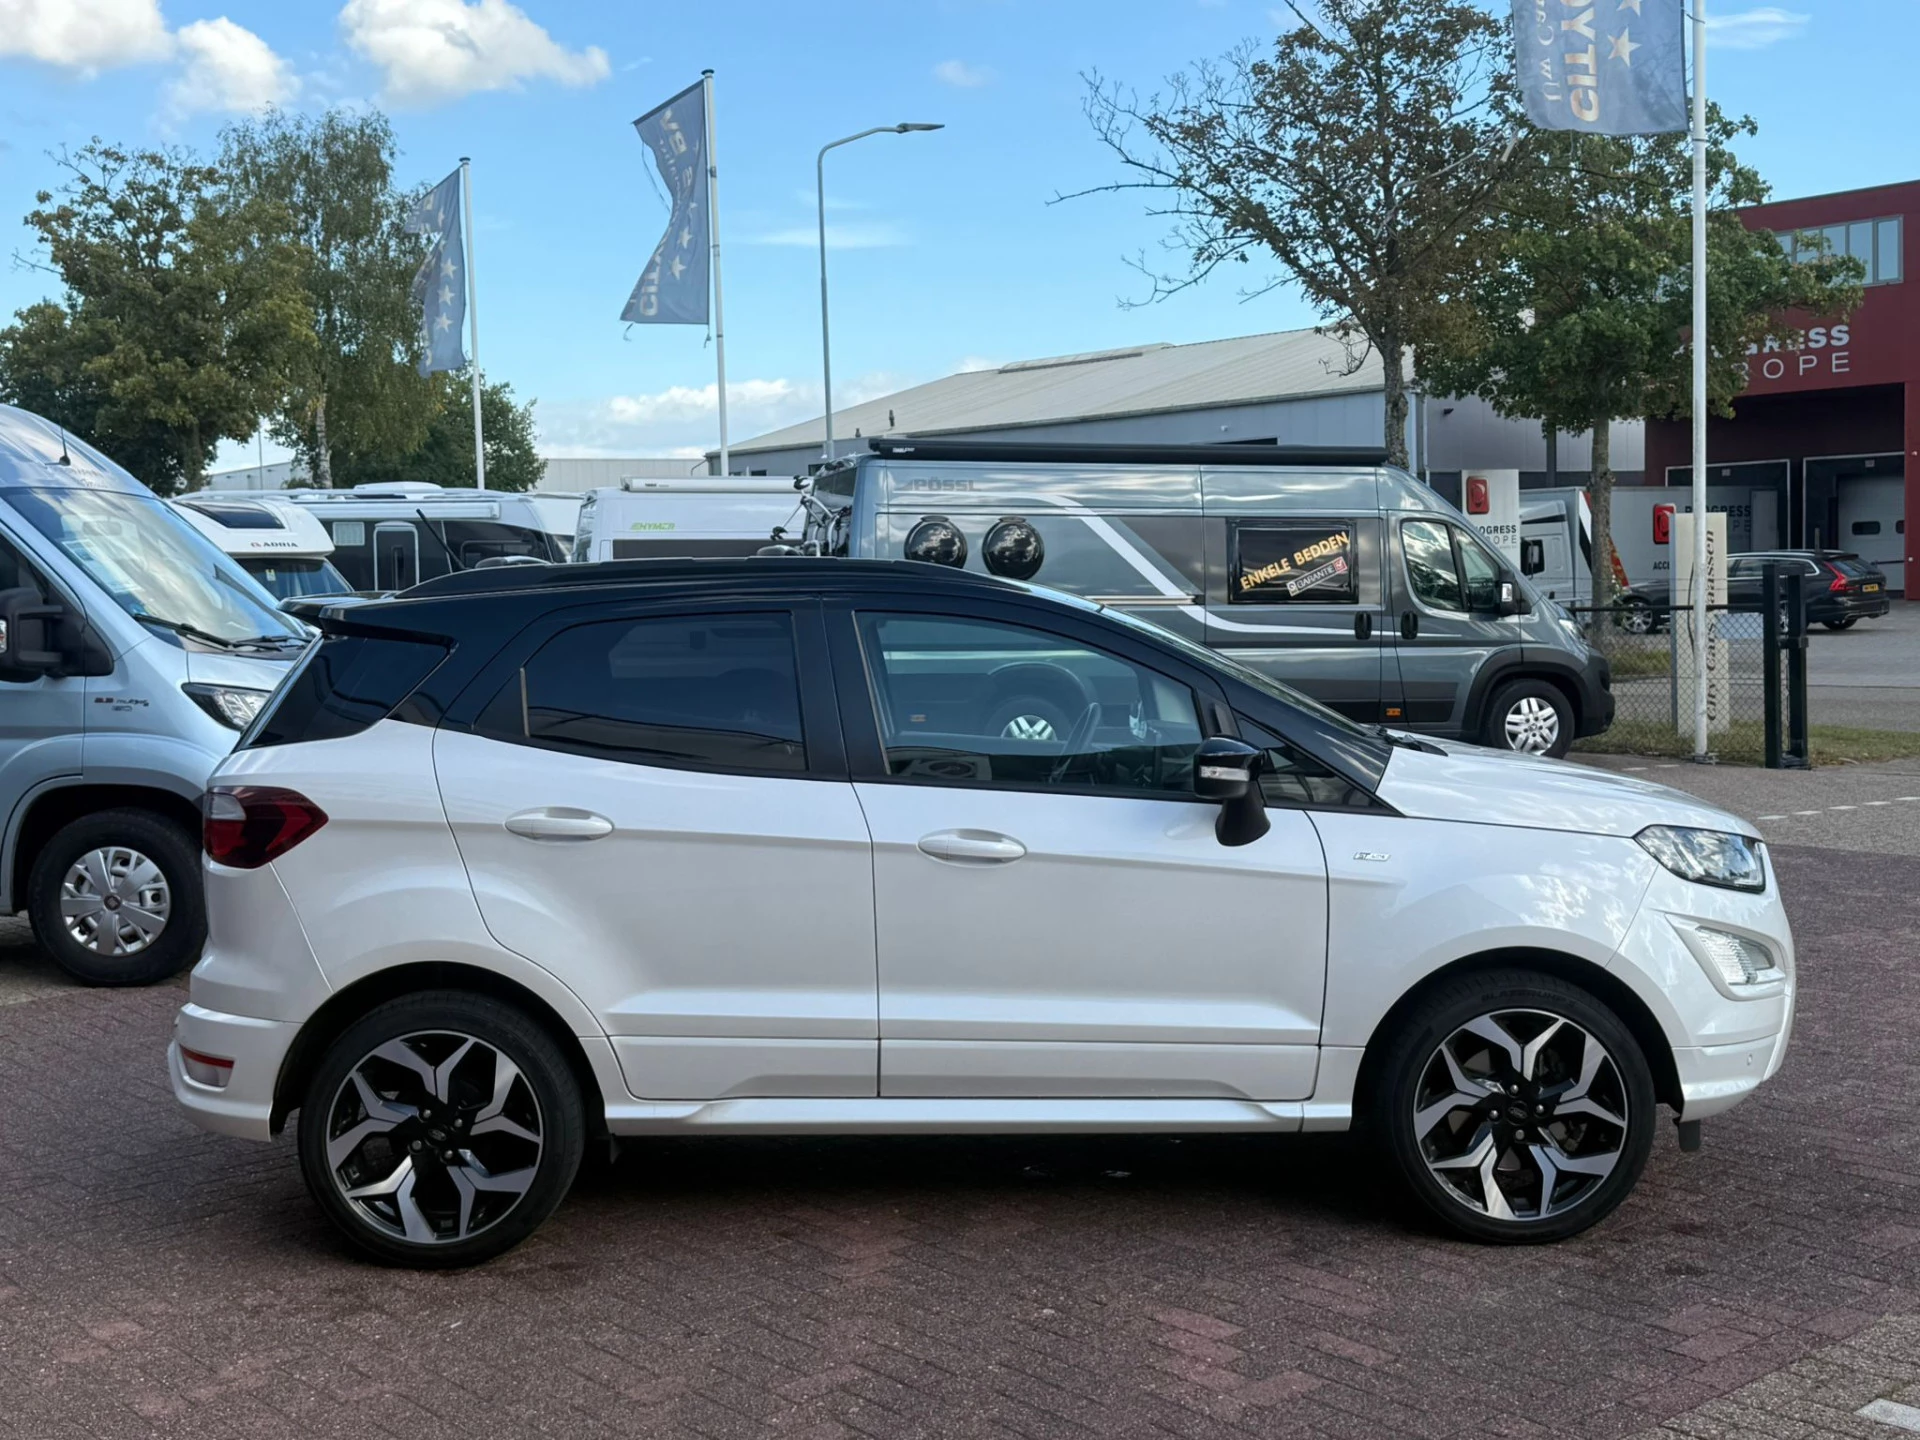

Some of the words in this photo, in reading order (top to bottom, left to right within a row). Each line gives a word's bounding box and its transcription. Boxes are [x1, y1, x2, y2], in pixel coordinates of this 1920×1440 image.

[1475, 524, 1517, 536] OGRESS
[1240, 557, 1292, 590] ENKELE
[1293, 531, 1350, 566] BEDDEN
[1706, 530, 1716, 608] aassen
